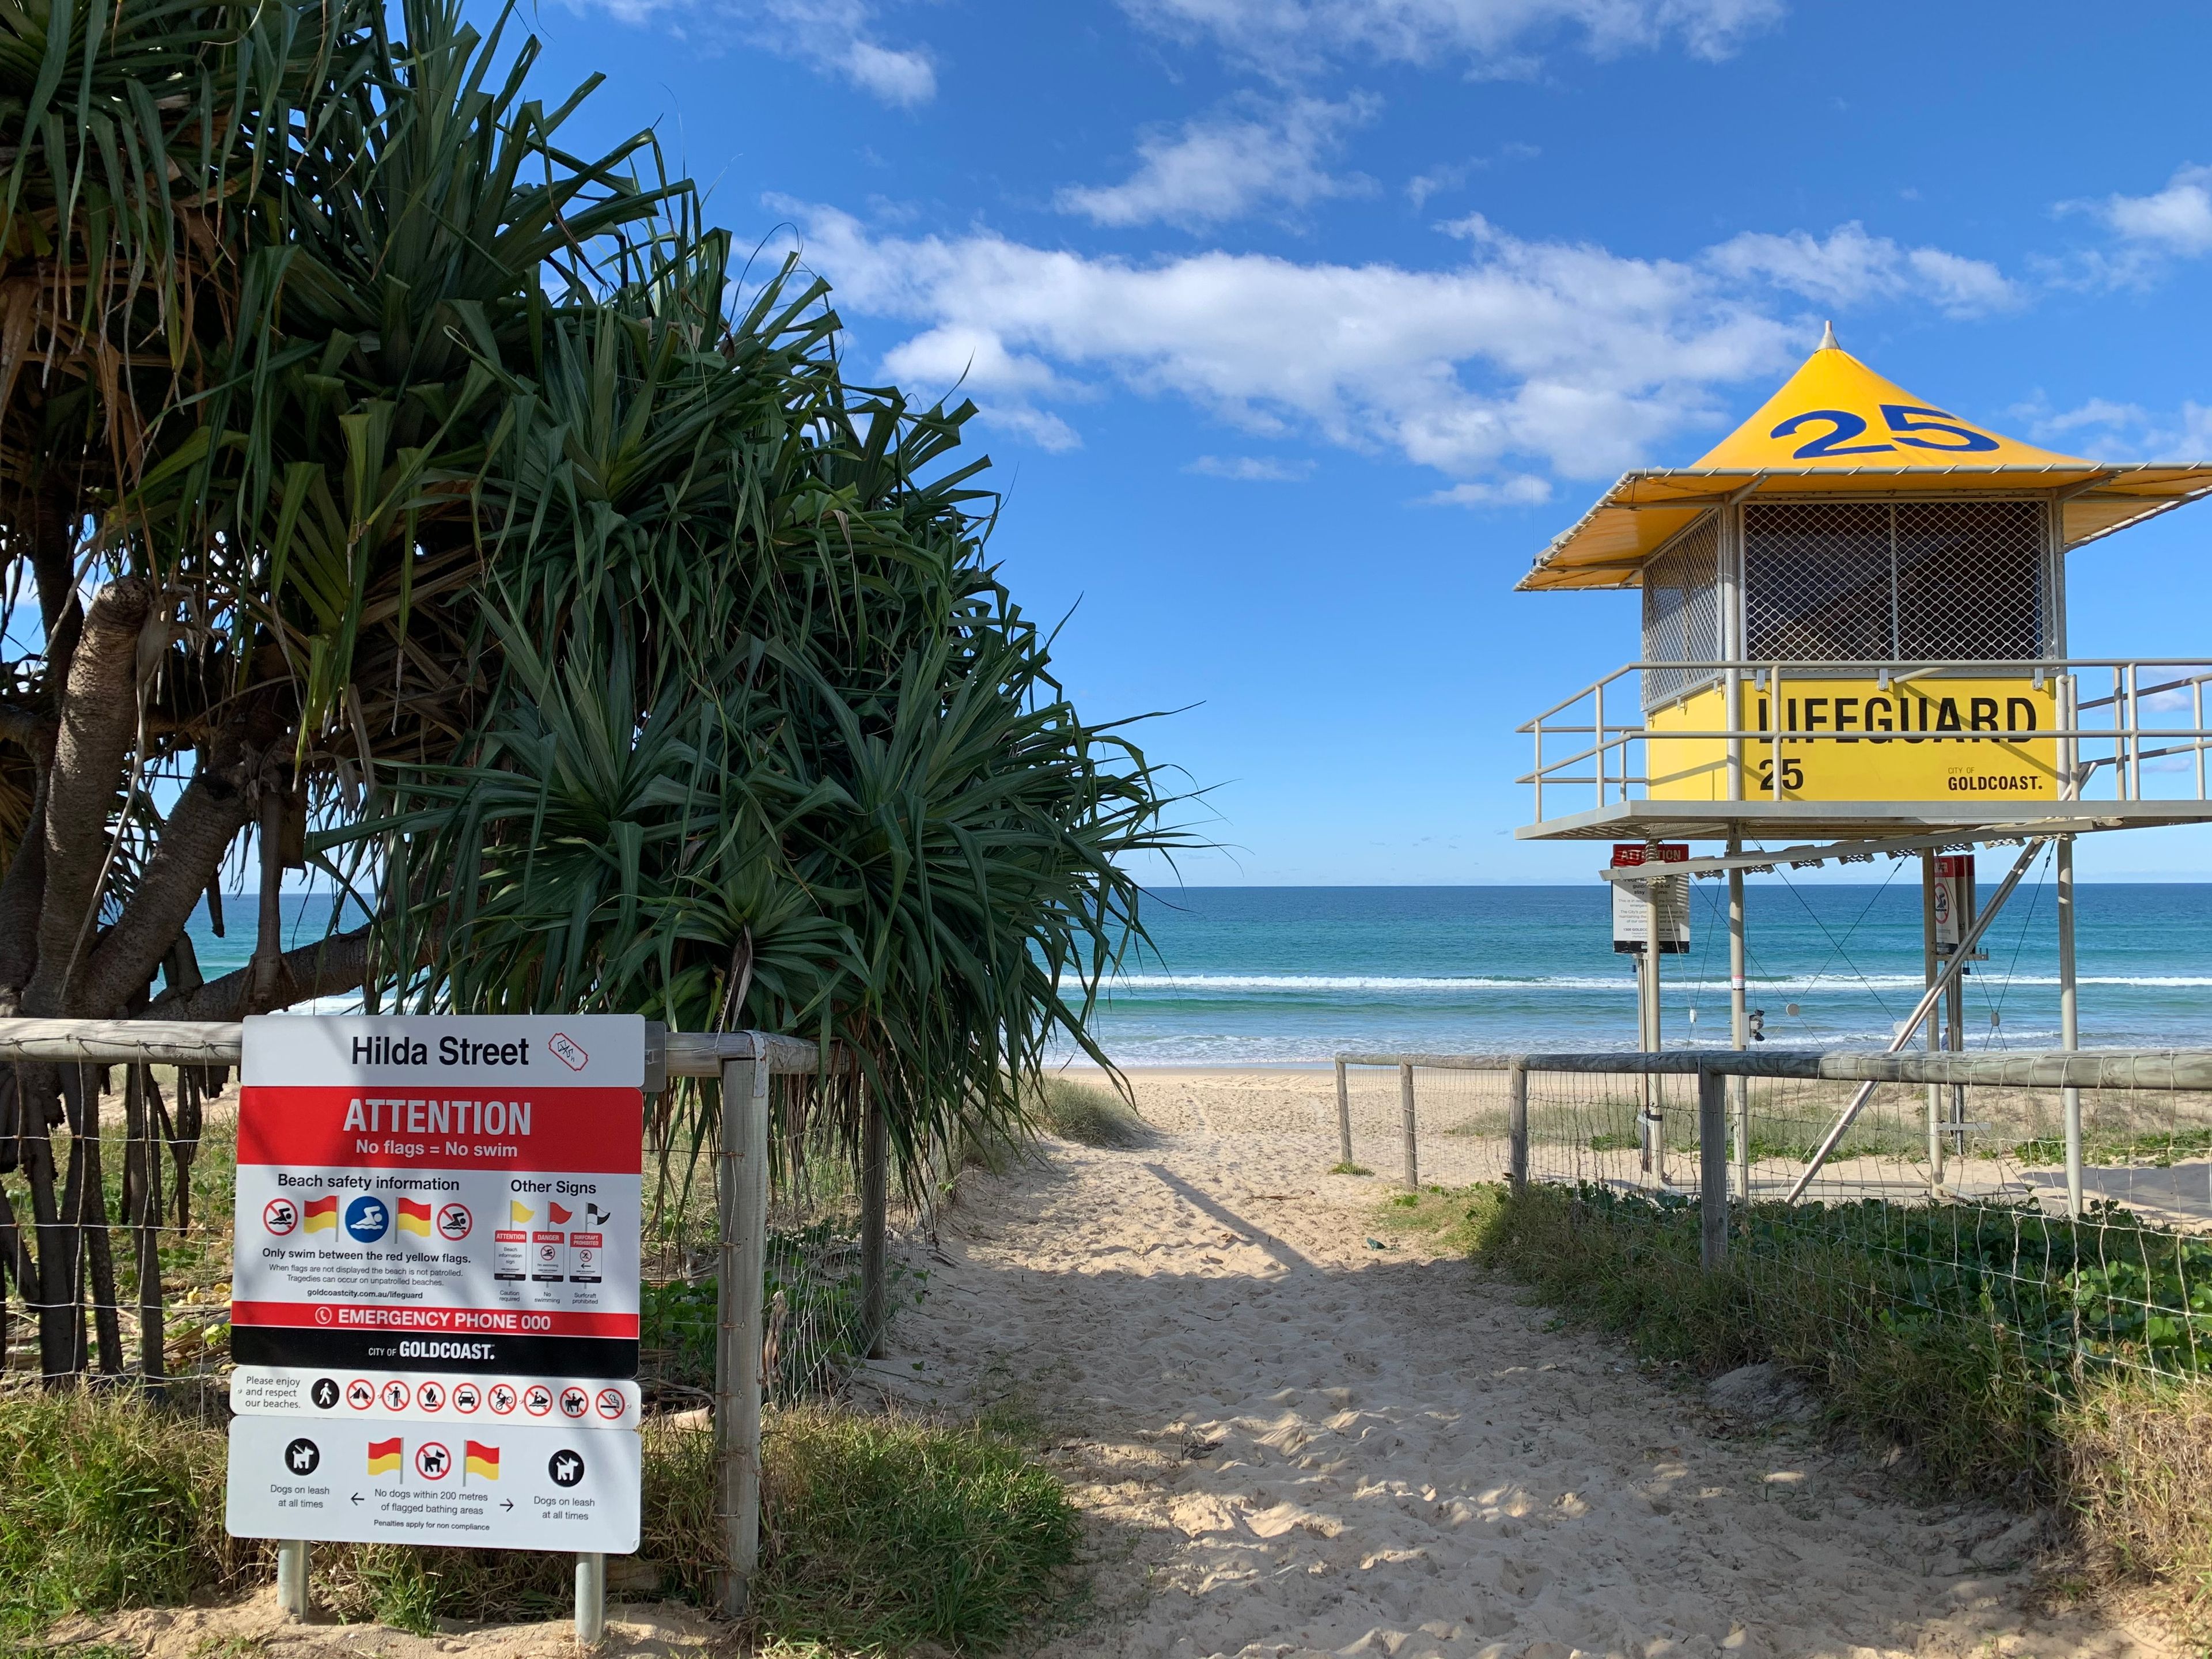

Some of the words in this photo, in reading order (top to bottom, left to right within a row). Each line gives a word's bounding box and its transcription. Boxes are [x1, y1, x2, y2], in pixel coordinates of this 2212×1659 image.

[1770, 404, 2000, 460] 25
[1759, 697, 2036, 744] LIFEGUARD
[1759, 758, 1804, 791] 25
[352, 1036, 427, 1065] Hilda
[438, 1036, 529, 1065] Street
[343, 1098, 531, 1135] ATTENTION
[356, 1139, 379, 1154] No
[384, 1140, 424, 1158] flags
[445, 1141, 468, 1156] No
[474, 1142, 518, 1157] swim
[278, 1173, 323, 1187] Beach
[327, 1175, 372, 1191] safety
[376, 1176, 460, 1191] information
[510, 1179, 552, 1192] Other
[556, 1180, 596, 1196] Signs
[263, 1248, 286, 1259] Only
[288, 1249, 316, 1259] swim
[319, 1249, 363, 1260] between
[366, 1251, 382, 1260] the
[386, 1252, 403, 1261] red
[406, 1252, 440, 1263] yellow
[442, 1253, 471, 1264] flags.
[269, 1263, 289, 1271] When
[291, 1264, 308, 1273] flags
[336, 1267, 370, 1275] displayed
[430, 1269, 463, 1277] patrolled.
[287, 1274, 321, 1283] Tragedies
[370, 1277, 410, 1285] unpatrolled
[412, 1278, 444, 1286] beaches.
[307, 1289, 423, 1300] goldcoastcity.com.au/lifeguard
[338, 1309, 450, 1327] EMERGENCY
[454, 1312, 517, 1330] PHONE
[521, 1315, 551, 1331] 000
[368, 1347, 385, 1357] CITY
[387, 1347, 396, 1357] OF
[246, 1376, 274, 1385] Please
[276, 1377, 301, 1388] enjoy
[245, 1387, 263, 1396] and
[265, 1389, 297, 1399] respect
[263, 1399, 301, 1408] beaches.
[270, 1484, 292, 1495] Dogs
[308, 1486, 329, 1495] leash
[374, 1488, 387, 1498] No
[389, 1489, 411, 1499] dogs
[412, 1490, 438, 1499] within
[440, 1491, 456, 1500] 200
[459, 1493, 488, 1501] metres
[278, 1499, 286, 1507] at
[288, 1499, 298, 1508] all
[300, 1499, 324, 1508] times
[533, 1496, 556, 1507] Dogs
[572, 1497, 595, 1507] leash
[381, 1502, 390, 1511] of
[392, 1503, 423, 1514] flagged
[426, 1504, 457, 1516] bathing
[460, 1507, 483, 1515] areas
[542, 1510, 551, 1518] at
[552, 1511, 563, 1519] all
[565, 1511, 589, 1521] times
[374, 1519, 404, 1527] Penalties
[406, 1521, 425, 1529] apply
[451, 1522, 490, 1531] compliance
